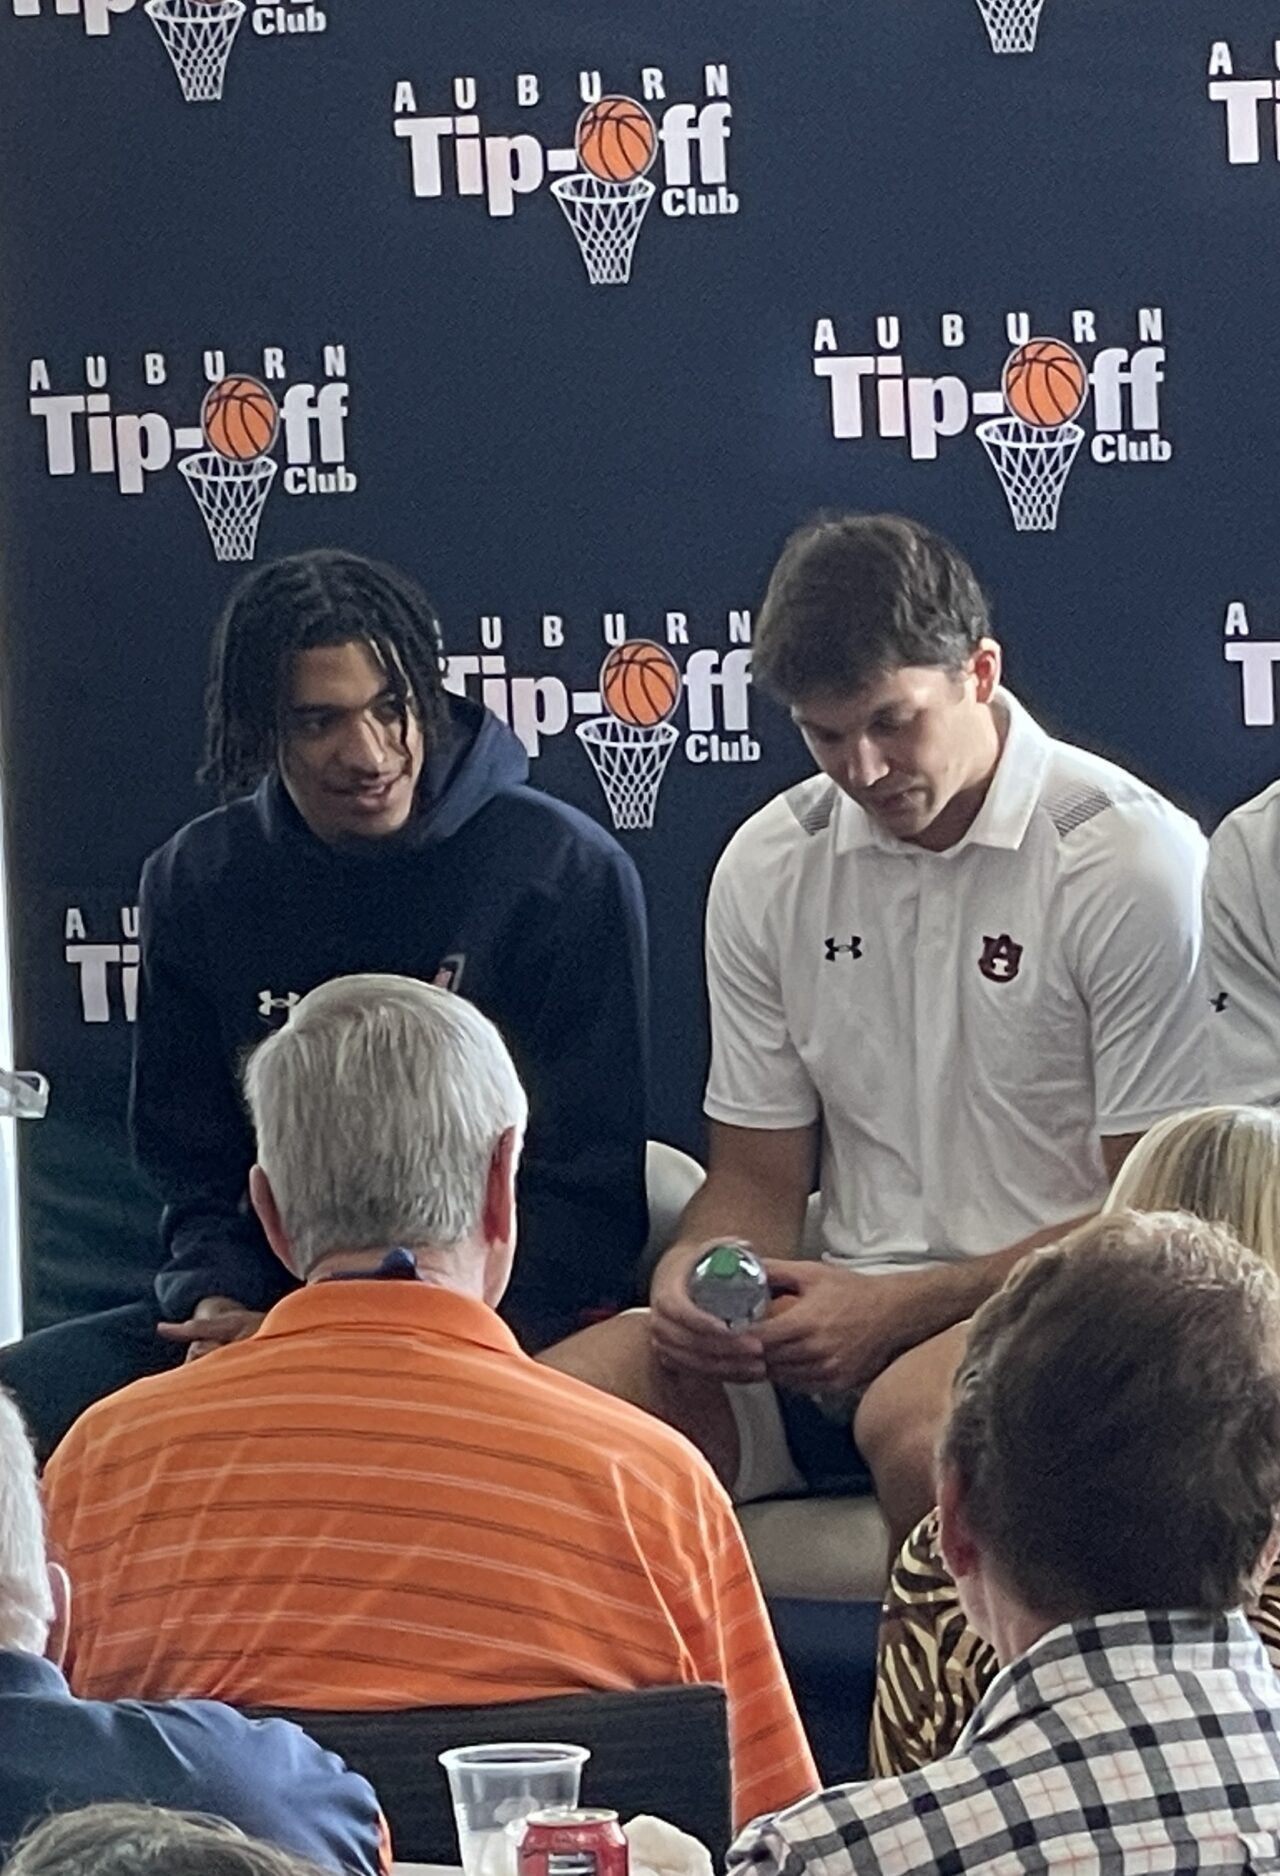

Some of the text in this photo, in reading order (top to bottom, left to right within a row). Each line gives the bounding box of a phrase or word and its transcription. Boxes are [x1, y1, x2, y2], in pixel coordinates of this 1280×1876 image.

[253, 6, 327, 34] Club
[395, 64, 729, 112] AUBURN
[662, 187, 739, 216] Club
[815, 308, 1163, 351] AUBURN
[30, 345, 346, 390] AUBURN
[1091, 433, 1172, 462] Club
[284, 466, 357, 494] Club
[434, 611, 751, 649] UBURN
[686, 734, 761, 763] Club
